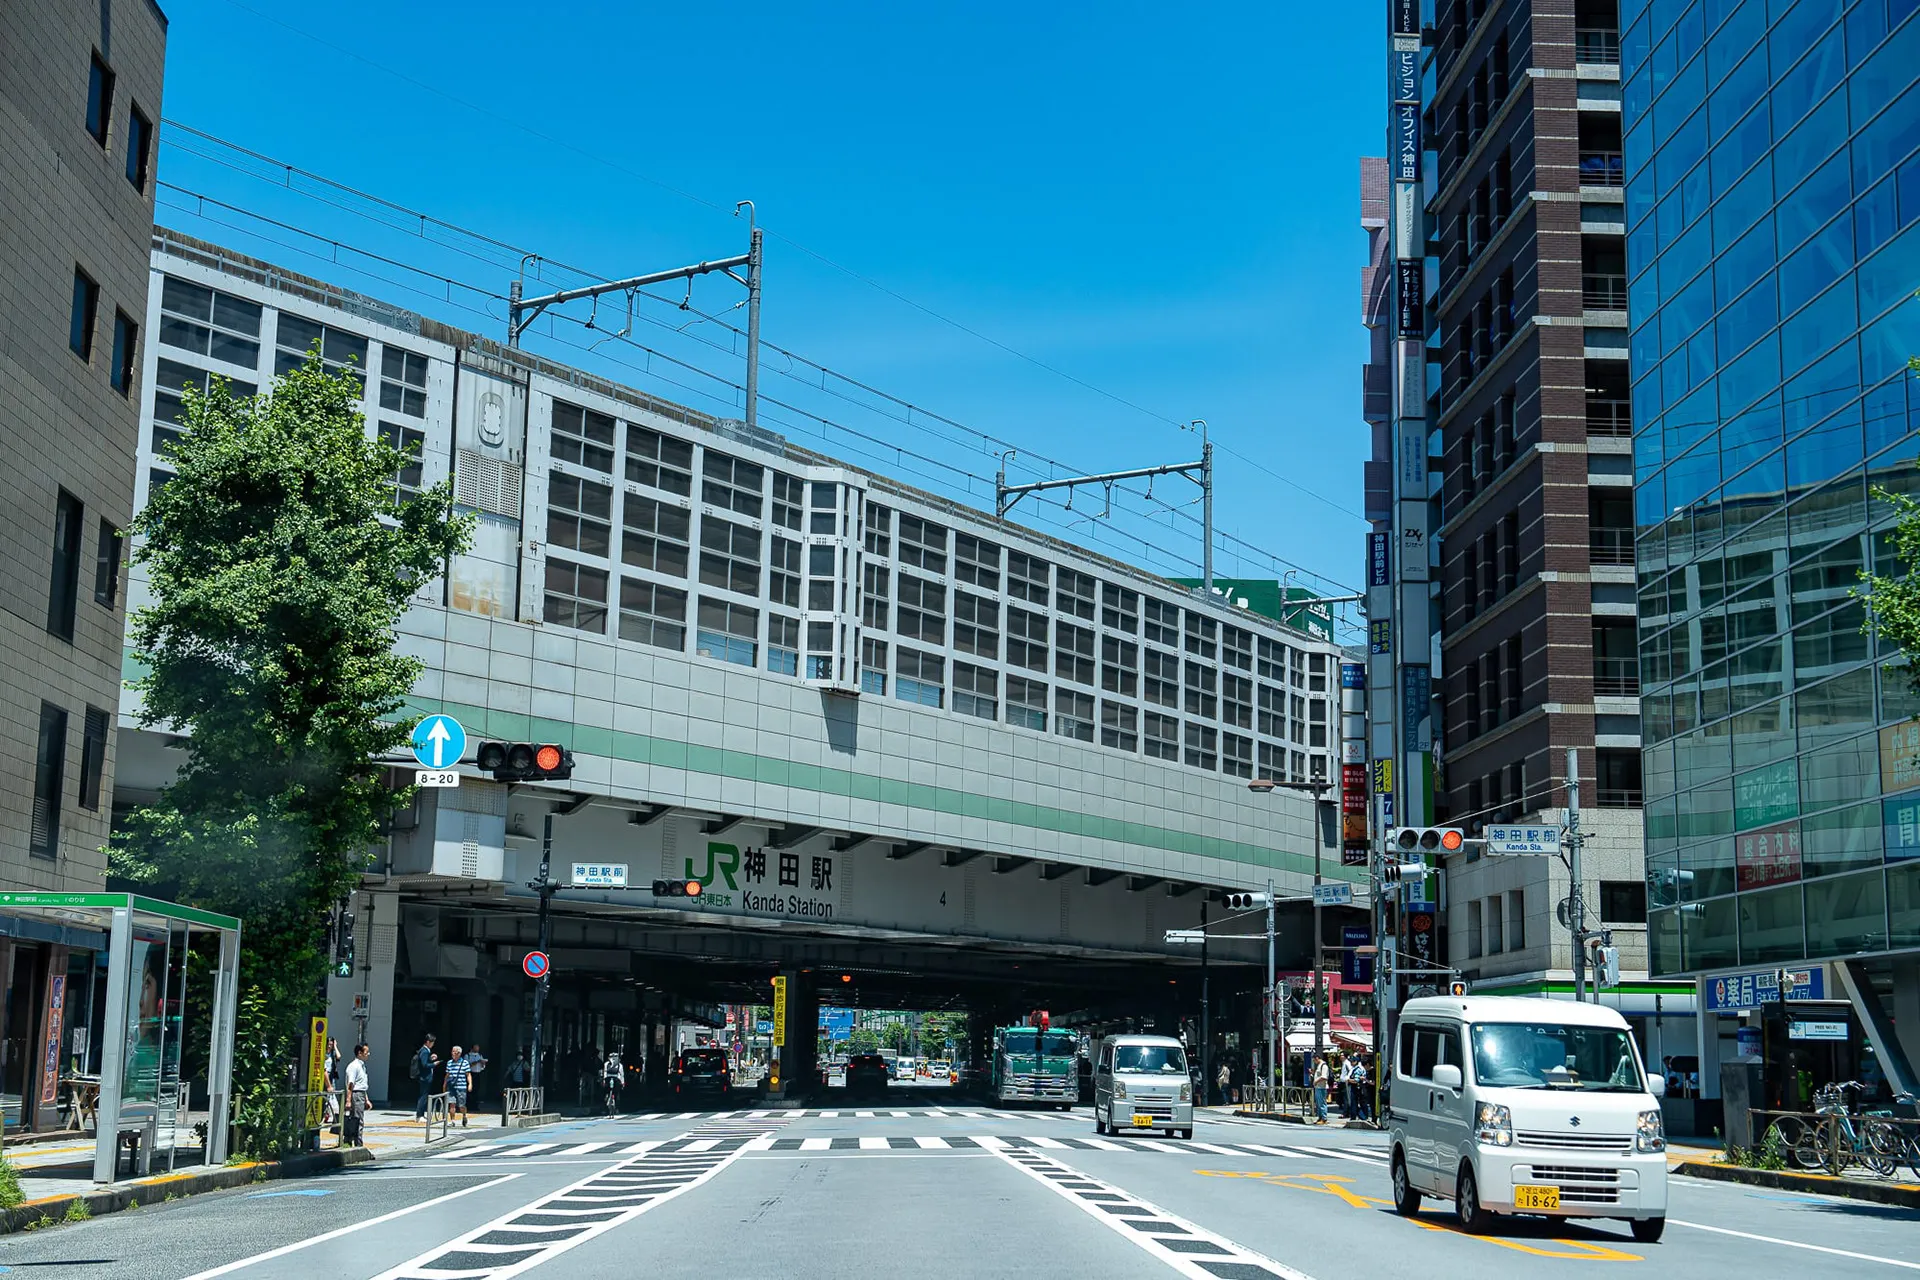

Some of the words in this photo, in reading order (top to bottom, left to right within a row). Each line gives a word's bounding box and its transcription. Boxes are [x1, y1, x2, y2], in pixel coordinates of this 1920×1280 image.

[1374, 534, 1385, 585] 神田駅前ビル
[420, 774, 454, 784] 8-20
[1374, 759, 1383, 793] レンタル
[1492, 829, 1556, 842] 神田駅前
[1506, 843, 1528, 851] Kanda
[1529, 843, 1543, 851] Sta.
[575, 866, 624, 878] 神田駅前
[685, 842, 739, 890] JR
[744, 846, 833, 891] 神田駅
[743, 891, 784, 913] Kanda
[788, 894, 833, 918] Station
[939, 891, 947, 907] 4
[1727, 977, 1753, 1006] 薬局
[1526, 1195, 1557, 1208] 18-62
